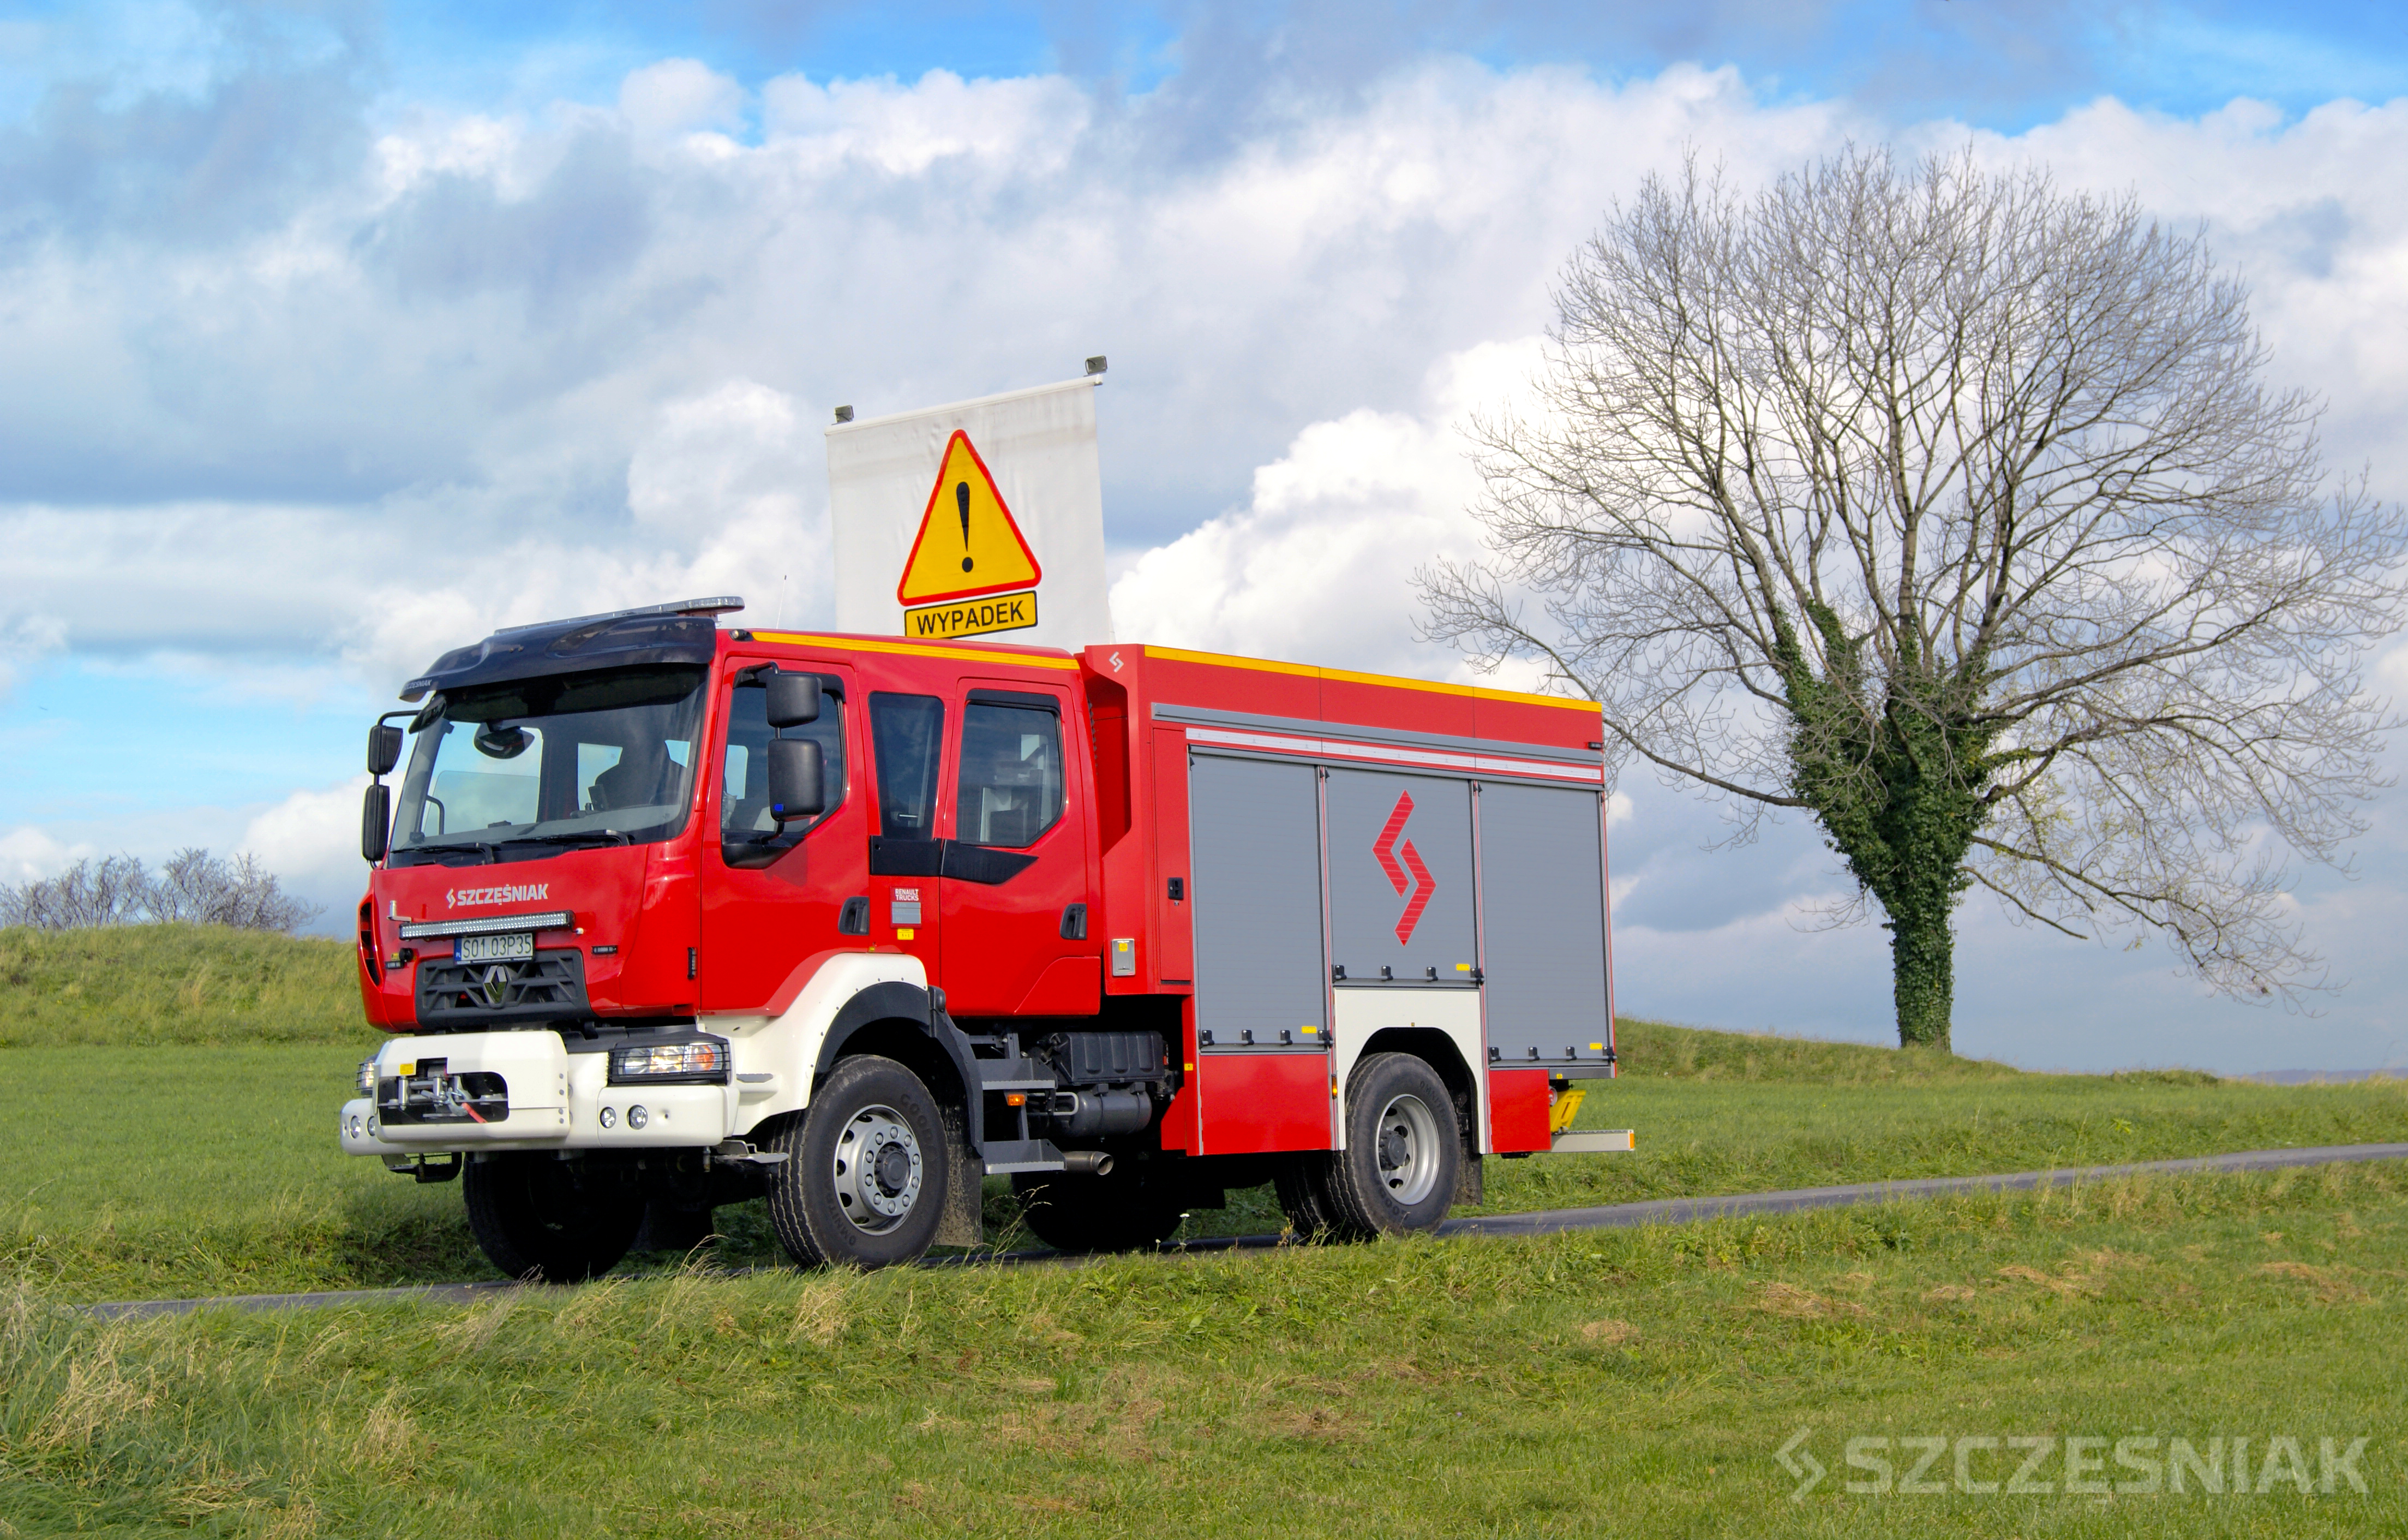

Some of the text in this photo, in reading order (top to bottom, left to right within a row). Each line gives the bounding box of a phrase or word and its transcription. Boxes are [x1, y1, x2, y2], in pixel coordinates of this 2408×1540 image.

[917, 600, 1025, 635] WYPADEK
[457, 884, 548, 906] SZCZĘŚNIAK
[492, 935, 531, 956] 03P35
